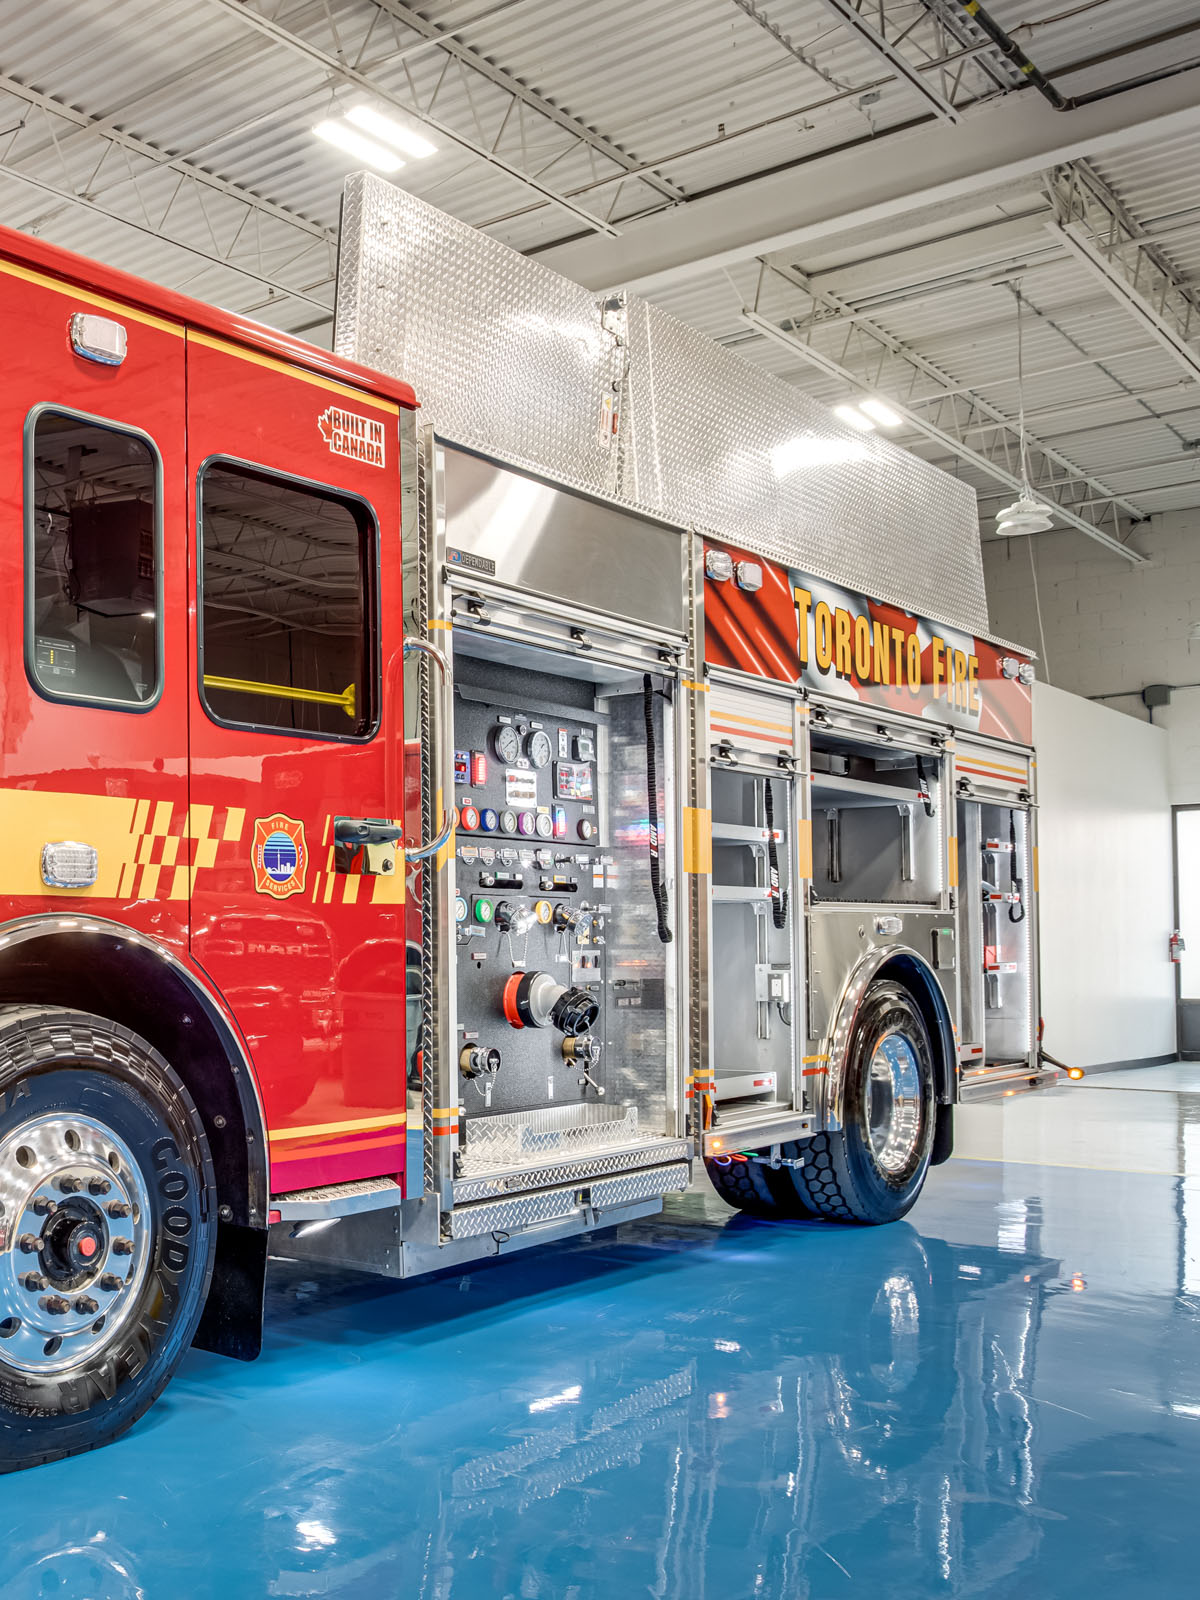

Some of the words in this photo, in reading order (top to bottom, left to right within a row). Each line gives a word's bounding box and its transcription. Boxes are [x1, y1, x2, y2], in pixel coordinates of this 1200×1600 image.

[333, 410, 366, 438] BUILT
[370, 423, 382, 444] IN
[334, 432, 383, 465] CANADA
[461, 553, 495, 572] DEPENDABLE
[794, 588, 921, 695] TORONTO
[933, 636, 979, 713] FIRE
[272, 822, 289, 831] FIRE
[266, 880, 295, 892] SERVICES
[58, 1136, 191, 1415] GOODYEAR
